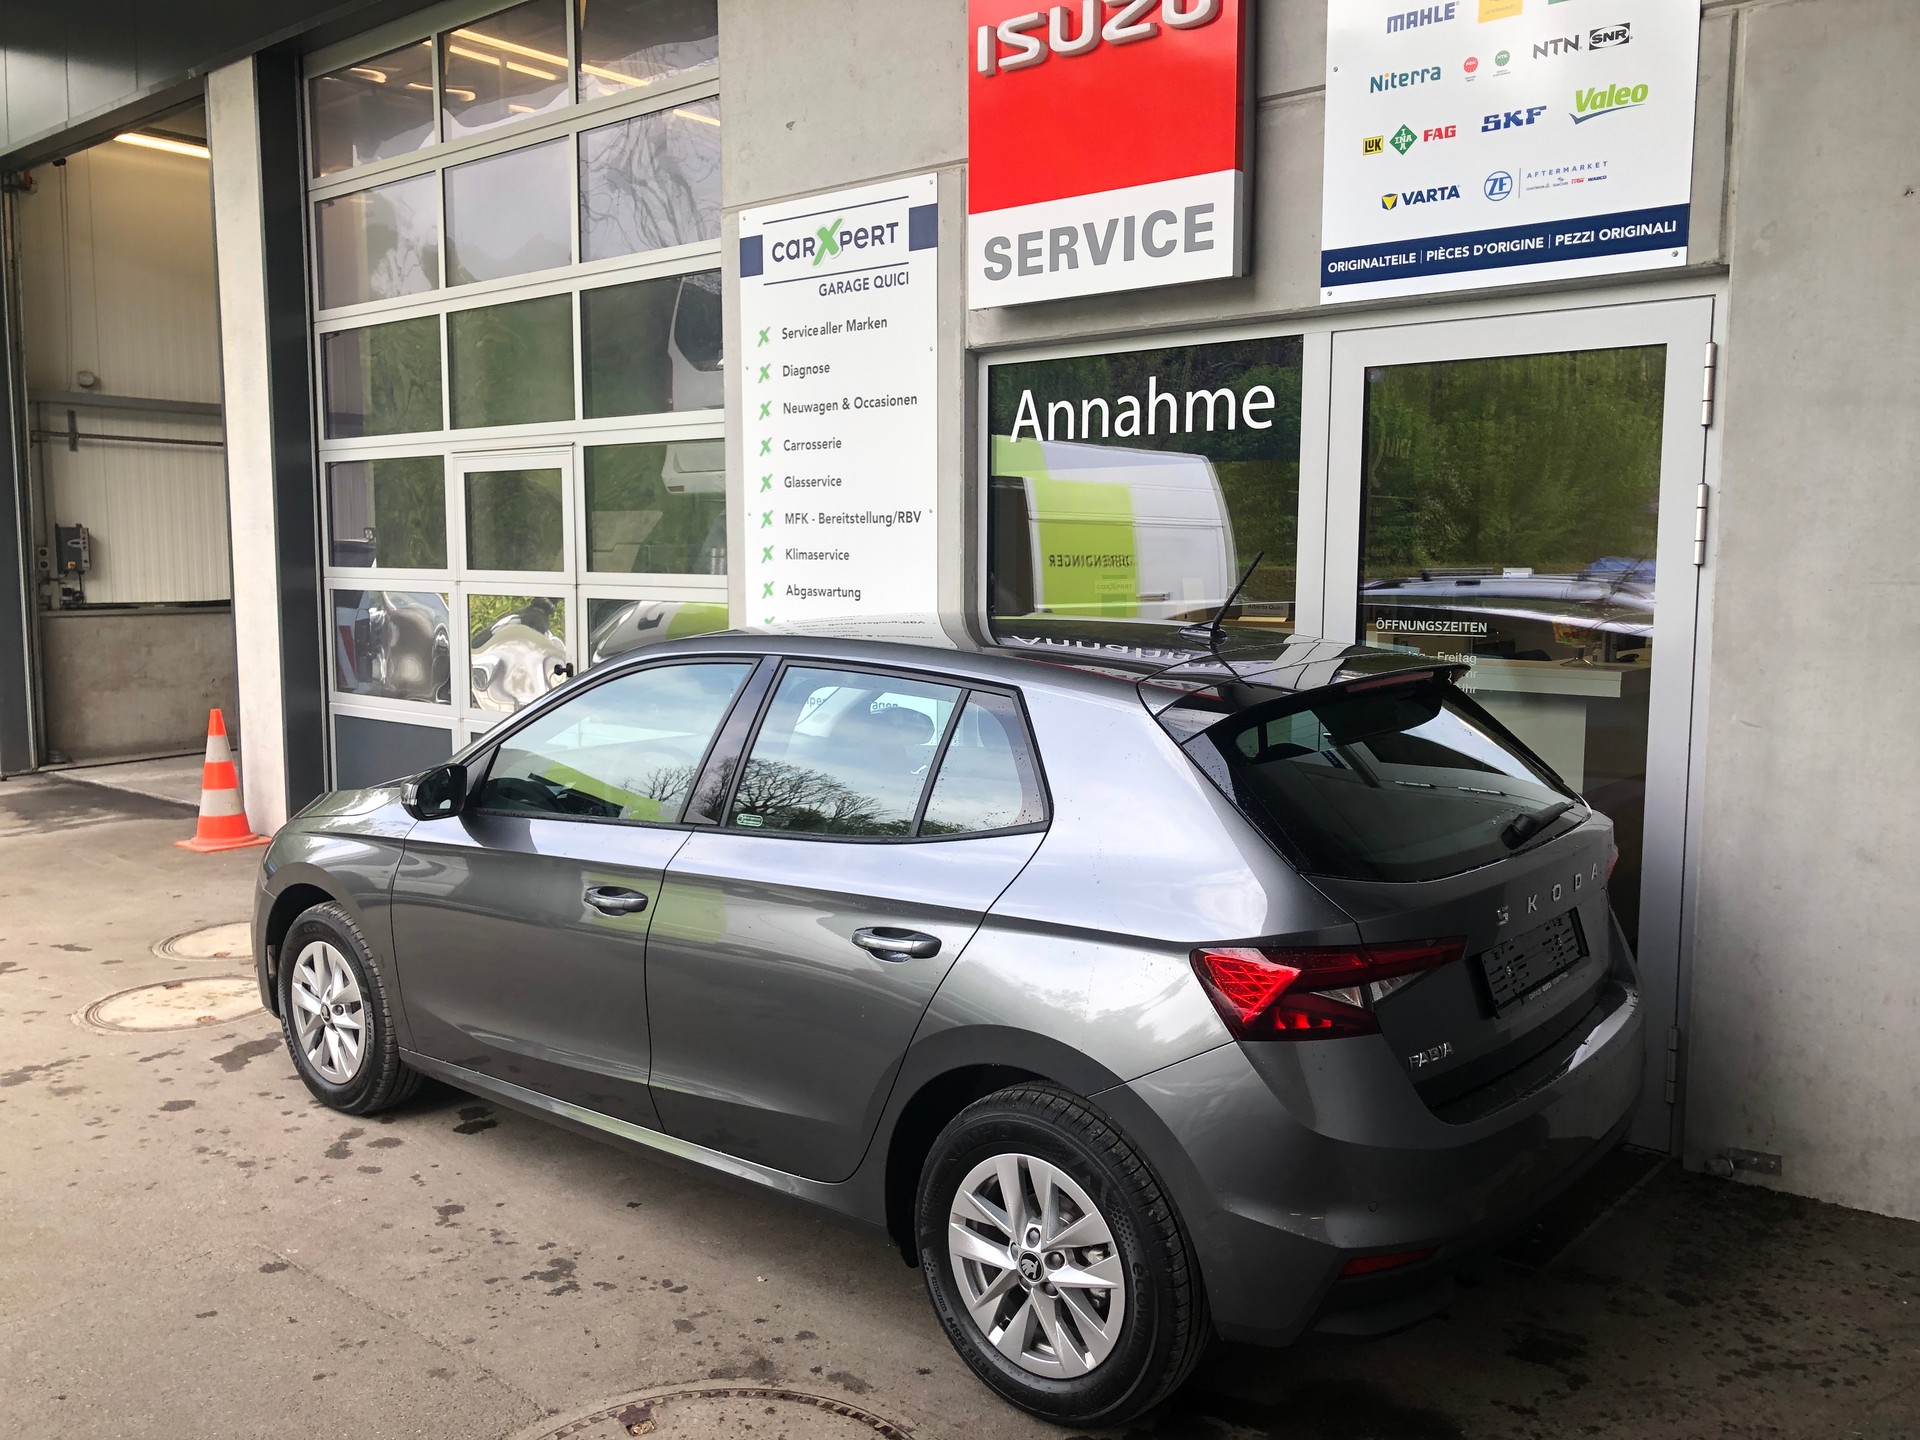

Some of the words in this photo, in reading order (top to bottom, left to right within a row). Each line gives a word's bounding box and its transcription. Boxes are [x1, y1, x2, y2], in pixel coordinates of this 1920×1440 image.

[1387, 2, 1456, 34] MAHLE
[1533, 34, 1580, 60] NTN
[1591, 29, 1629, 44] SNR
[1370, 66, 1442, 93] Niterra
[1575, 83, 1649, 113] Valeo
[1481, 105, 1547, 133] SKF
[1423, 125, 1456, 142] FAG
[1527, 161, 1608, 179] AFTERMARKET
[1402, 185, 1461, 206] VARTA
[1485, 176, 1512, 196] ZF
[983, 202, 1215, 281] SERVICE
[1327, 253, 1417, 273] ORIGINALTEILE
[1426, 246, 1470, 262] PIÈCES
[1555, 230, 1595, 246] PEZZI
[1598, 220, 1677, 241] ORIGINALI
[818, 277, 870, 297] GARAGE
[873, 271, 910, 289] QUICI
[781, 325, 819, 340] Service
[819, 321, 843, 336] aller
[846, 317, 888, 333] Marken
[782, 363, 831, 379] Diagnose
[783, 399, 839, 415] Neuwagen
[842, 397, 850, 410] &
[854, 394, 918, 410] Occasionen
[1009, 375, 1276, 443] Annahme
[783, 436, 842, 451] Carrosserie
[784, 475, 842, 488] Glasservice
[784, 512, 809, 525] MFK
[818, 511, 922, 527] Bereitstellung/RBV
[785, 548, 850, 561] Klimaservice
[786, 585, 862, 601] Abgaswartung
[1376, 617, 1488, 633] ÖFFNUNGSZEITEN
[1437, 651, 1477, 665] Freitag
[1408, 1041, 1453, 1071] FABIA
